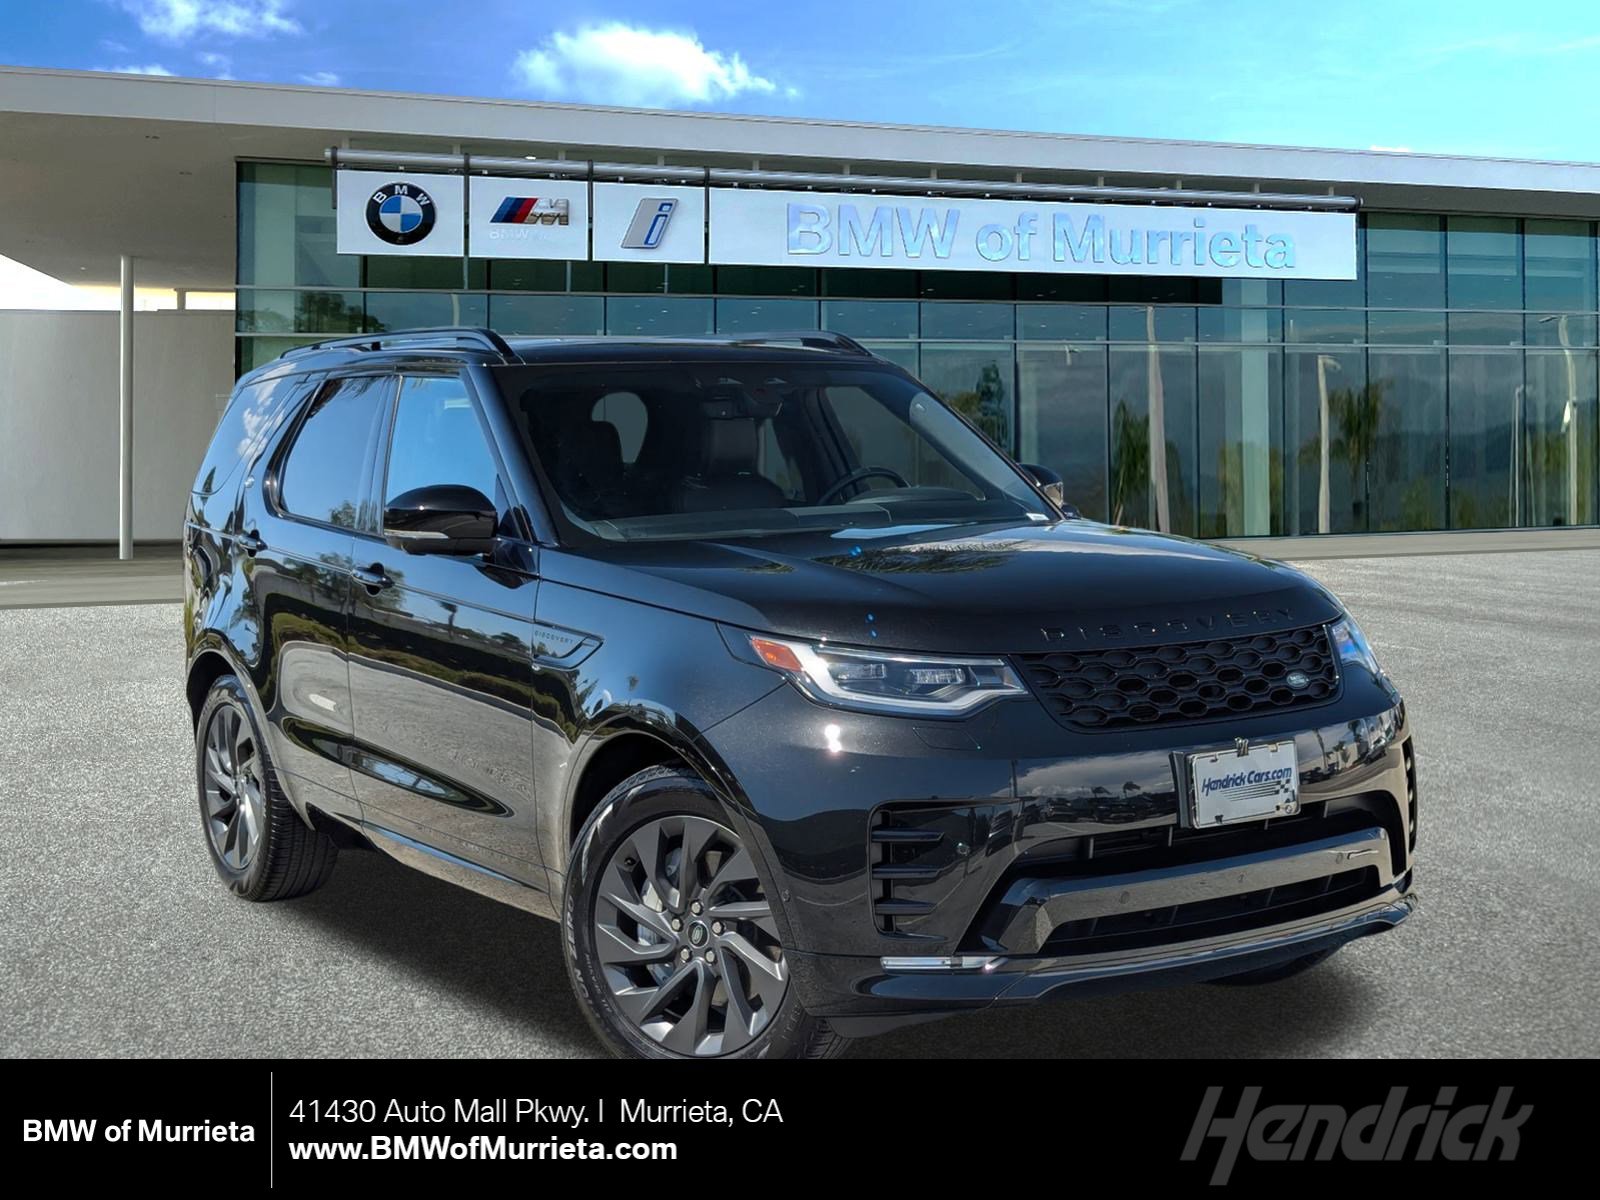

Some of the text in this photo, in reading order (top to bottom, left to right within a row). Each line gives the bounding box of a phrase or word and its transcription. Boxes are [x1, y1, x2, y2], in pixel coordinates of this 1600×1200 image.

[373, 185, 430, 206] BMW
[786, 202, 1297, 269] BMW of Murrieta
[1201, 767, 1292, 797] Hendrick Cars.com
